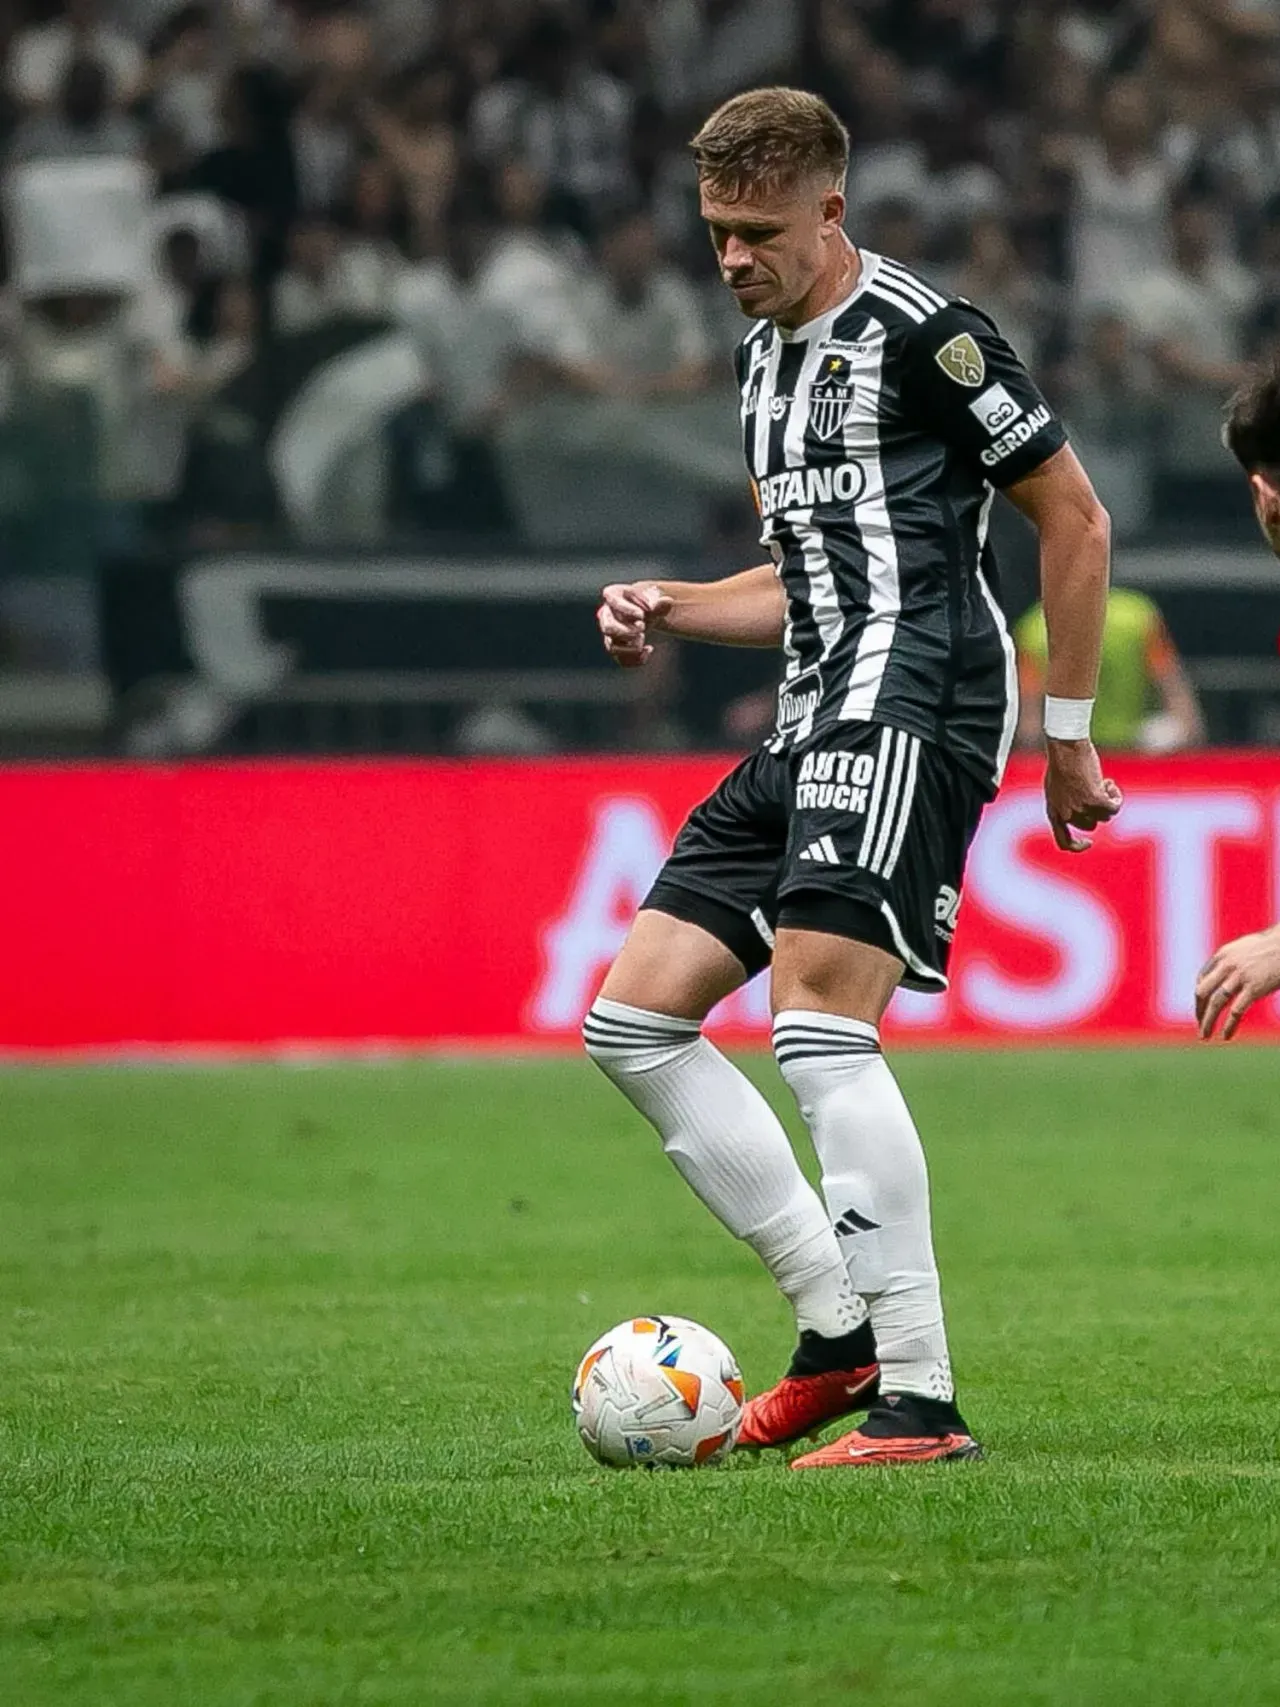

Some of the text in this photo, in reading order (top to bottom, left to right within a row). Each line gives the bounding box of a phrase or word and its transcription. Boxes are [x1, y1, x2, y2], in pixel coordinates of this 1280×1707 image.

[813, 387, 849, 399] CAM
[980, 403, 1051, 467] GERDAU
[760, 463, 862, 517] BETANO
[797, 750, 875, 787] AUTO
[796, 782, 869, 815] TRUCK
